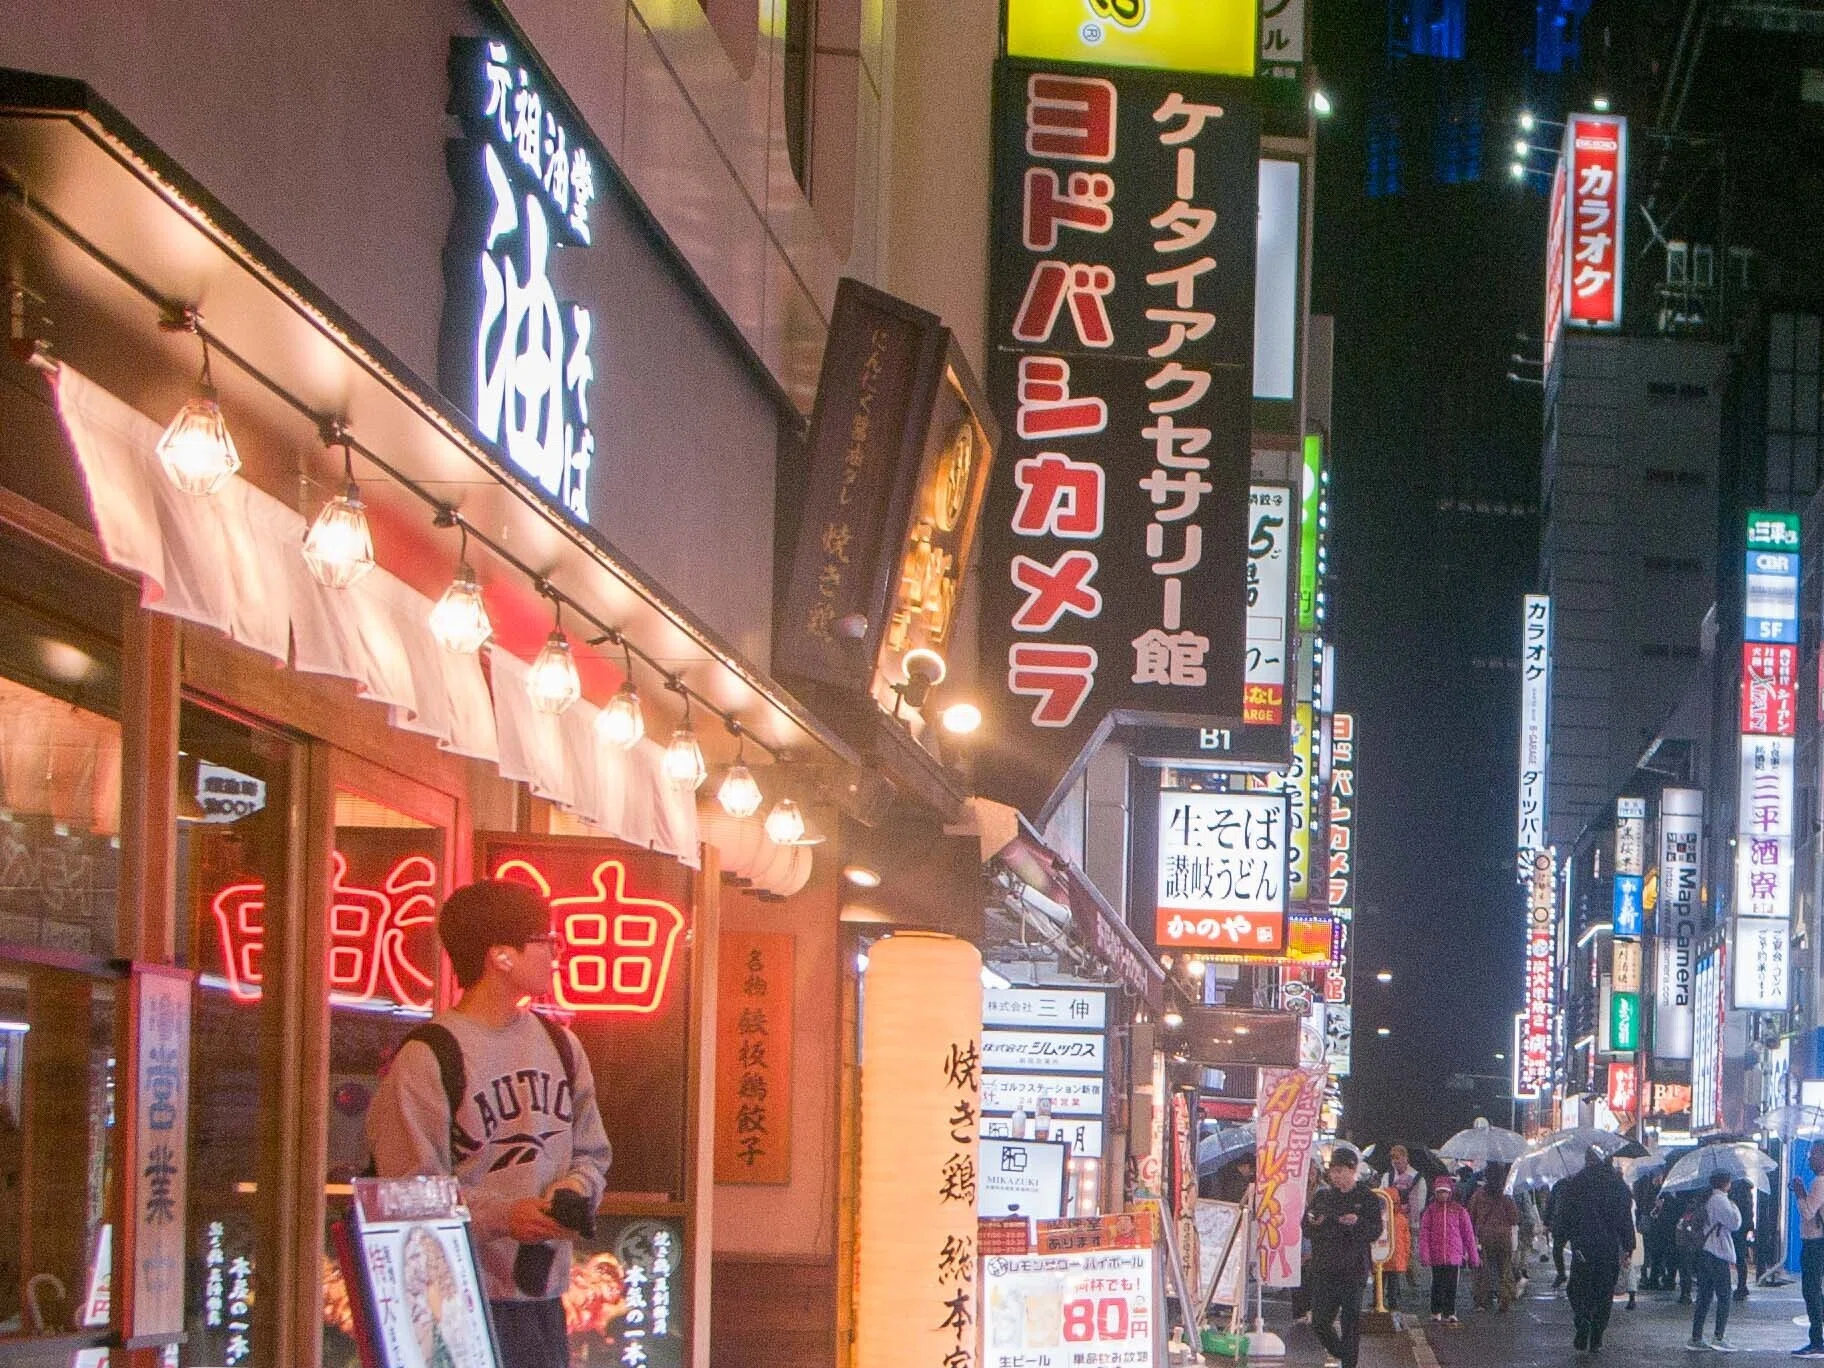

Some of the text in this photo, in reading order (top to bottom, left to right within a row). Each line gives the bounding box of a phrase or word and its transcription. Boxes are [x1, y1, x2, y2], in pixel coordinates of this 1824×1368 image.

[1574, 164, 1613, 297] カラオケ
[1008, 74, 1118, 732] ヨドバシカメラ
[1130, 91, 1224, 688] ケータイアクセサリー館
[1525, 603, 1547, 681] カラオケ
[1168, 804, 1281, 851] 生そば
[1521, 771, 1543, 845] ダーツバー
[1166, 854, 1278, 902] 讃岐うどん
[1167, 914, 1253, 944] かのや
[1672, 868, 1697, 1006] Map Camera
[1031, 1042, 1096, 1057] シムックス
[1000, 1081, 1100, 1096] ゴルフステーション新宿
[938, 1039, 979, 1208] 焼き鶏
[986, 1176, 1039, 1187] MIKAZUKI
[1000, 1354, 1051, 1368] 生ビール
